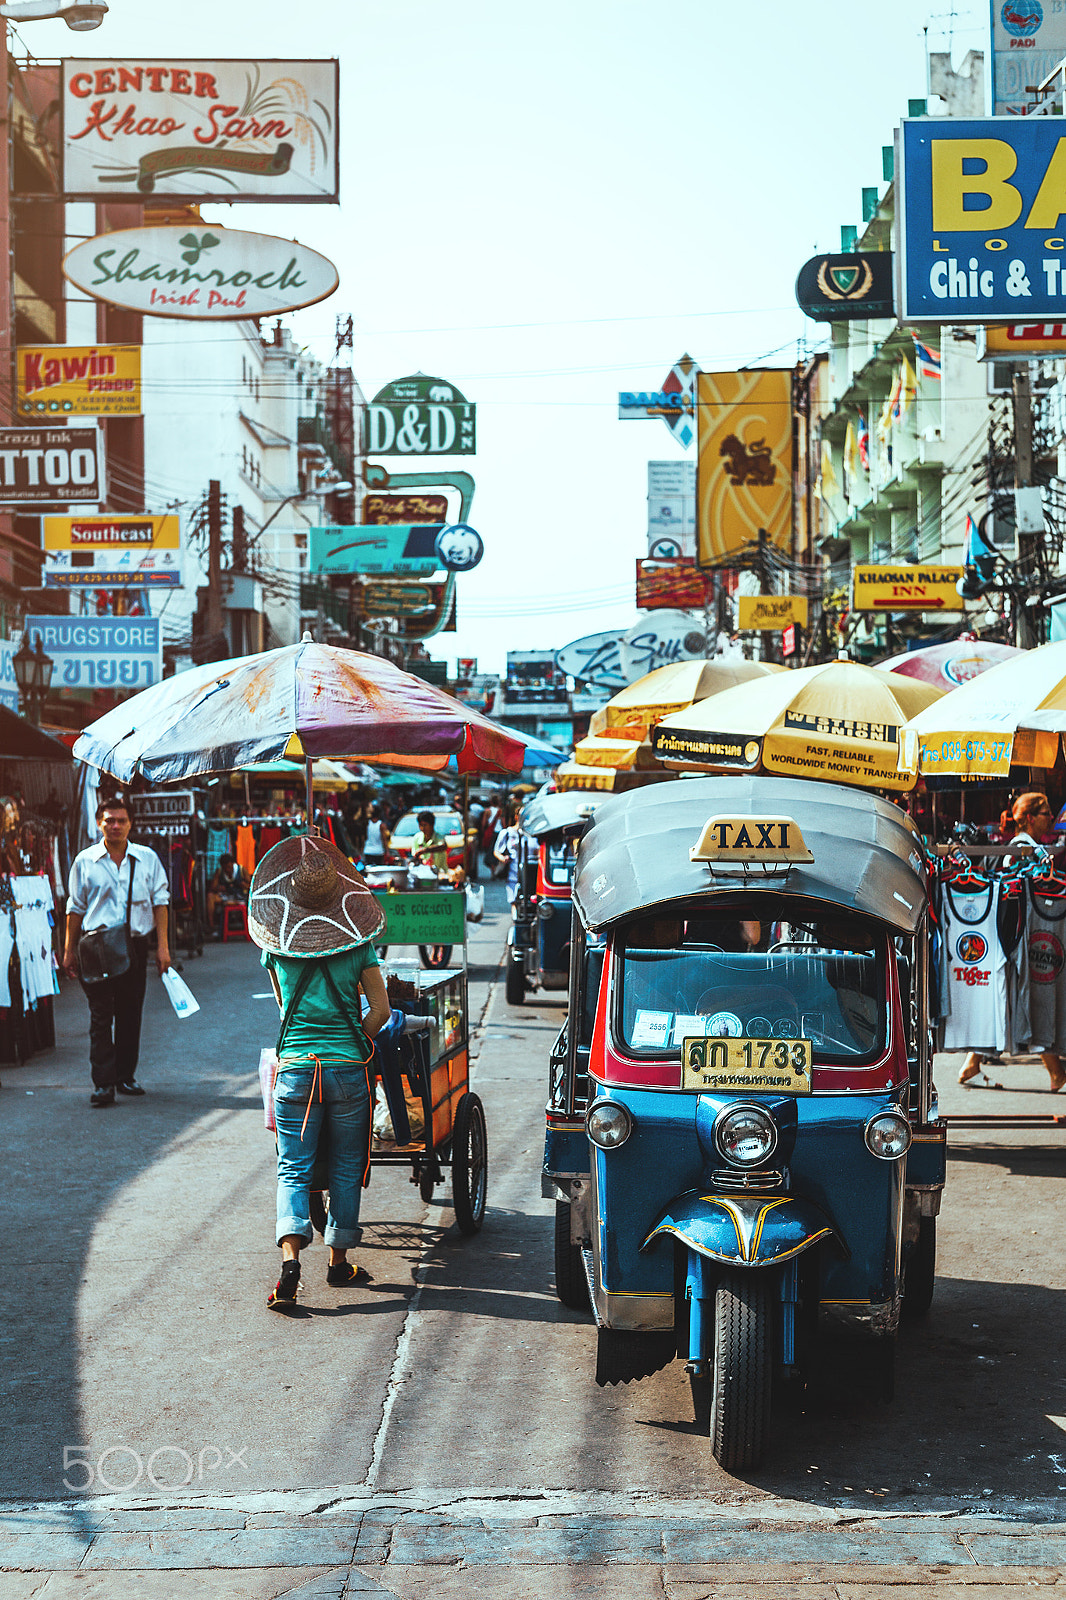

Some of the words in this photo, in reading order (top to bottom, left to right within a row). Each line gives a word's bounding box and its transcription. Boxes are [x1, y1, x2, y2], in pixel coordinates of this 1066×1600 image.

[1010, 38, 1036, 48] PADI
[69, 67, 218, 98] CENTER
[69, 100, 186, 141] Khao
[194, 104, 294, 144] Sarn
[932, 238, 1065, 252] LOC
[92, 249, 307, 289] Shamrock
[930, 257, 994, 299] Chic
[1006, 259, 1033, 297] &
[150, 288, 200, 306] Irish
[208, 289, 247, 309] Pub
[25, 350, 117, 396] Kawin
[46, 431, 72, 444] Ink
[367, 404, 456, 452] D&D
[461, 405, 473, 449] INN
[0, 449, 96, 486] TTOO
[57, 487, 97, 498] Studio
[71, 525, 153, 541] Southeast
[858, 573, 914, 584] KHAOSAN
[918, 573, 960, 584] PALACE
[892, 586, 926, 596] INN
[30, 627, 154, 646] DRUGSTORE
[630, 633, 683, 664] Silk
[62, 660, 153, 685] ขายยา
[786, 711, 885, 733] WESTERN
[816, 723, 884, 741] UNION
[806, 745, 831, 759] FAST,
[832, 749, 876, 765] RELIABLE,
[771, 754, 826, 770] WORLDWIDE
[827, 760, 861, 774] MONEY
[863, 766, 910, 782] TRANSFER
[134, 798, 187, 813] TATTOO
[136, 824, 190, 835] TATTOO
[713, 823, 790, 849] TAXI
[953, 966, 991, 987] Tiger
[649, 1022, 667, 1031] 2556
[742, 1041, 807, 1069] 1733
[702, 1074, 791, 1087] กรุงเทพมหานคร
